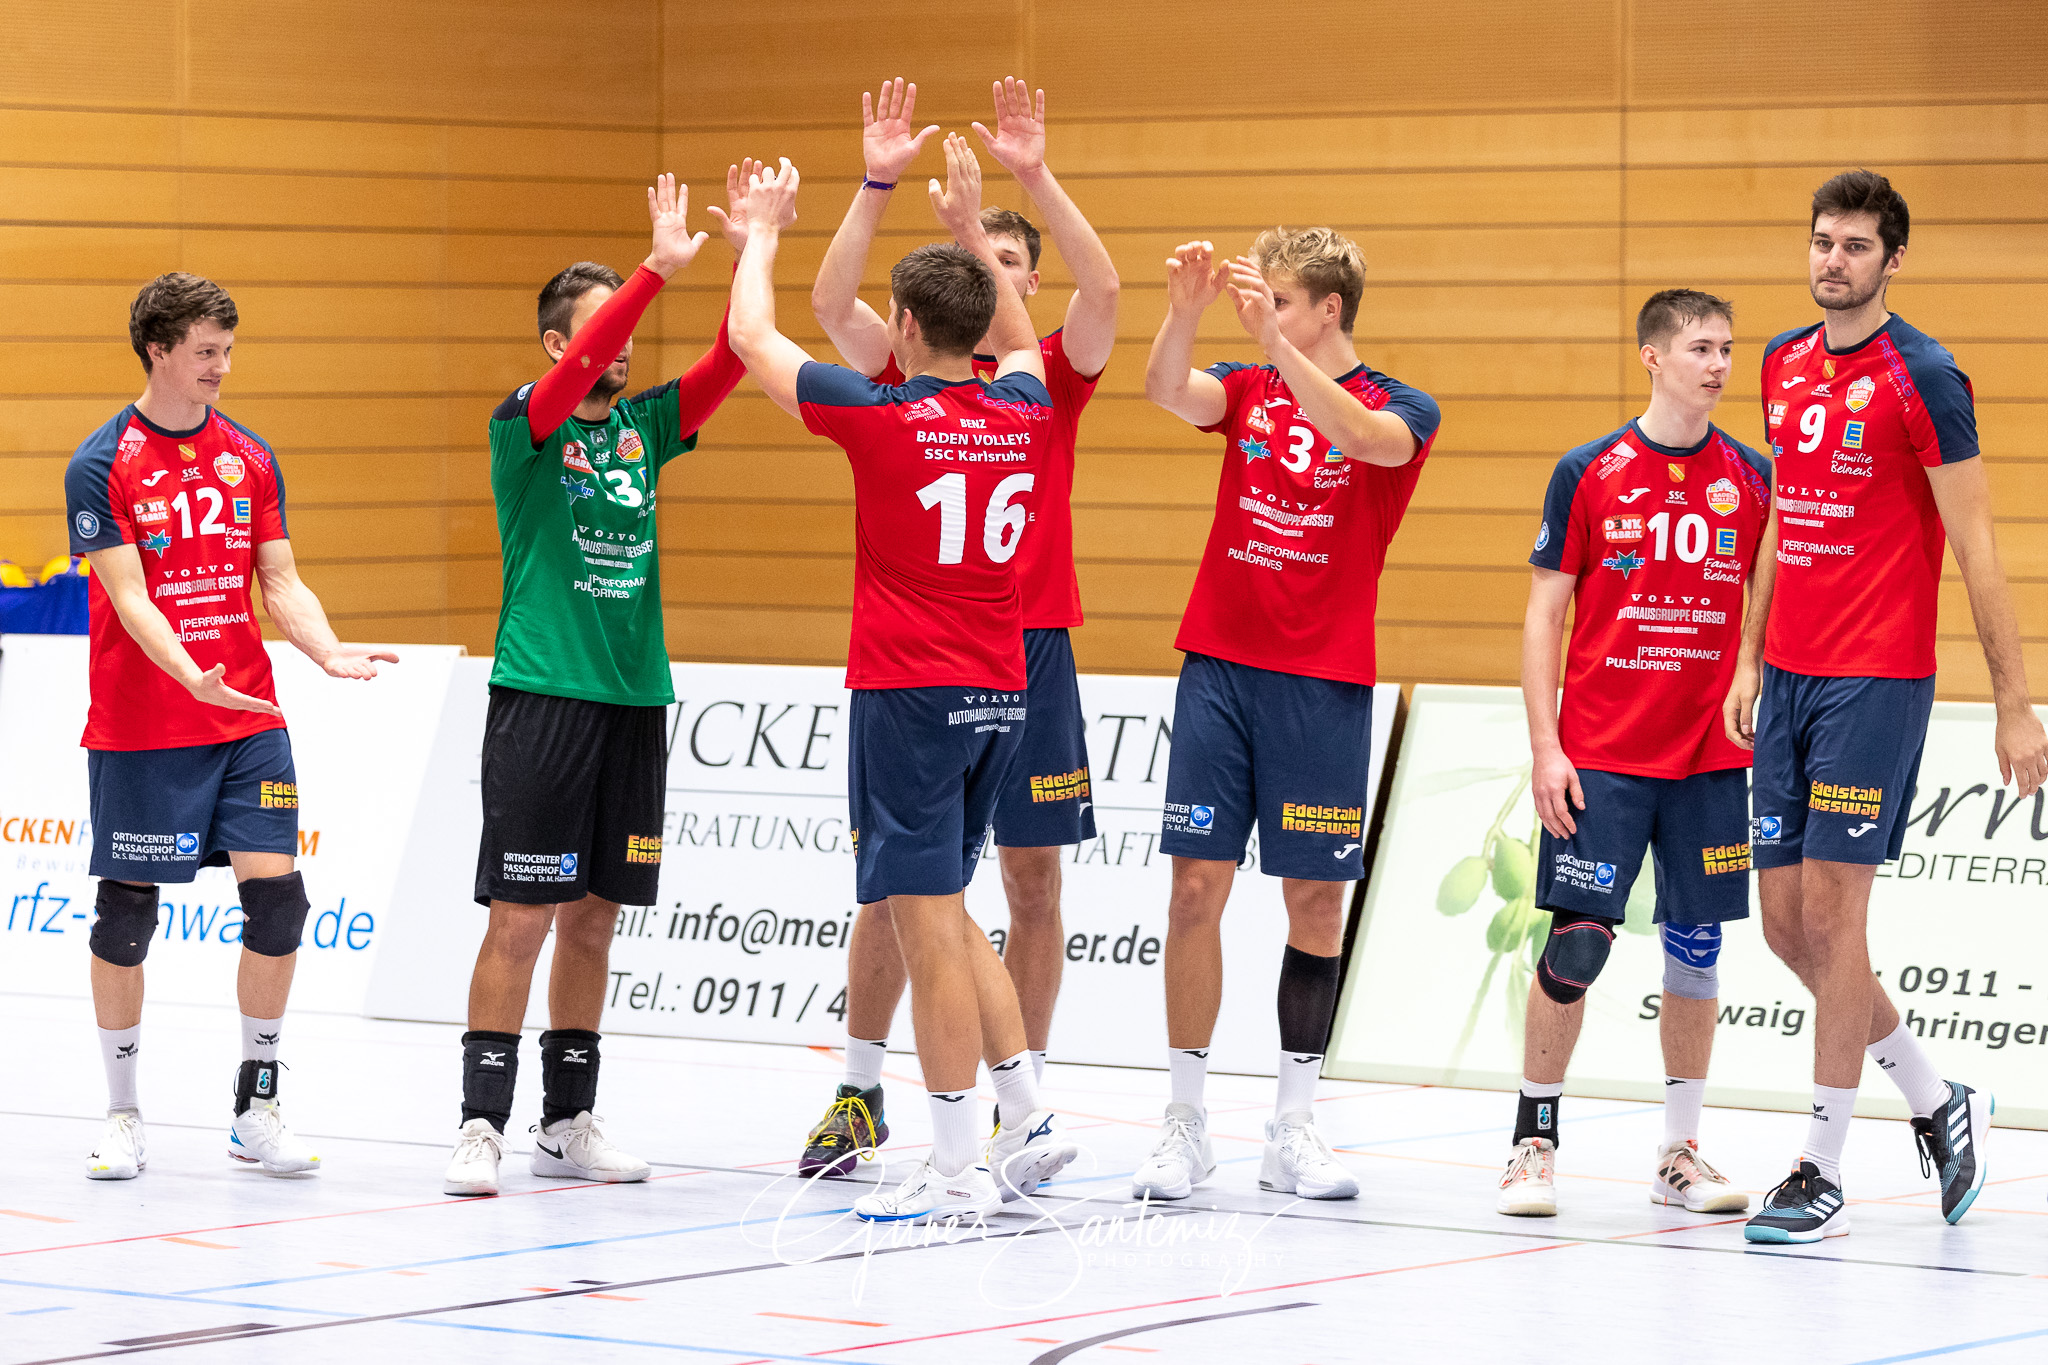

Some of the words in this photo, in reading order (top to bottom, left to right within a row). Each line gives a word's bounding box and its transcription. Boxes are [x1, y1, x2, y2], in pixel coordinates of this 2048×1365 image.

[1792, 341, 1806, 352] SSC
[1815, 384, 1831, 393] SSC
[960, 418, 987, 429] BENZ
[1797, 404, 1826, 453] 9
[916, 430, 969, 446] BADEN
[972, 432, 1031, 446] VOLLEYS
[595, 451, 611, 461] SSC
[924, 448, 954, 461] SSC
[958, 450, 1027, 463] Karlsruhe
[1600, 453, 1614, 465] SSC
[1832, 450, 1874, 464] Familie
[182, 467, 200, 478] SSC
[1250, 486, 1321, 511] VOLVO
[1668, 490, 1685, 500] SSC
[1778, 485, 1838, 499] VOLVO
[171, 487, 226, 539] 12
[1820, 502, 1855, 518] GEISSER
[915, 472, 1036, 565] 16
[1301, 514, 1334, 527] GEISSER
[577, 525, 636, 541] VOLVO
[1606, 530, 1642, 540] FABRIK
[1647, 512, 1709, 564] 10
[1251, 540, 1329, 564] PERFORMANCE
[1784, 539, 1855, 556] PERFORMANCE
[1248, 553, 1283, 571] DRIVES
[1704, 558, 1742, 571] Familie
[164, 563, 234, 578] VOLVO
[592, 588, 630, 599] DRIVES
[1631, 593, 1711, 606] VOLVO
[1692, 609, 1727, 625] GEISSER
[185, 629, 221, 642] DRIVES
[1641, 646, 1721, 661] PERFORMANCE
[1606, 656, 1637, 670] PULS
[1640, 660, 1682, 672] DRIVES
[963, 694, 1020, 704] VOLVO
[1811, 779, 1883, 803] Edelstahl
[1283, 802, 1362, 821] Edelstahl
[1808, 794, 1881, 820] Rosswag
[1166, 823, 1175, 831] Dr.
[1174, 825, 1183, 833] M.
[1183, 826, 1211, 836] Hammer
[1282, 816, 1361, 838] Rosswag
[112, 832, 175, 844] ORTHOCENTER
[1758, 838, 1781, 846] Hammer
[112, 842, 175, 855] PASSAGEHOF
[112, 852, 121, 860] Dr.
[128, 853, 148, 862] Blaich
[151, 854, 161, 862] Dr.
[161, 854, 170, 862] M.
[170, 854, 198, 862] Hammer
[504, 852, 560, 864] ORTHOCENTER
[503, 863, 559, 875] PASSAGEHOF
[516, 874, 535, 882] Blaich
[538, 875, 546, 883] Dr.
[1571, 879, 1580, 887] Dr.
[1900, 966, 1998, 997] 0911
[610, 971, 681, 1013] Tel.:
[693, 976, 786, 1018] 0911
